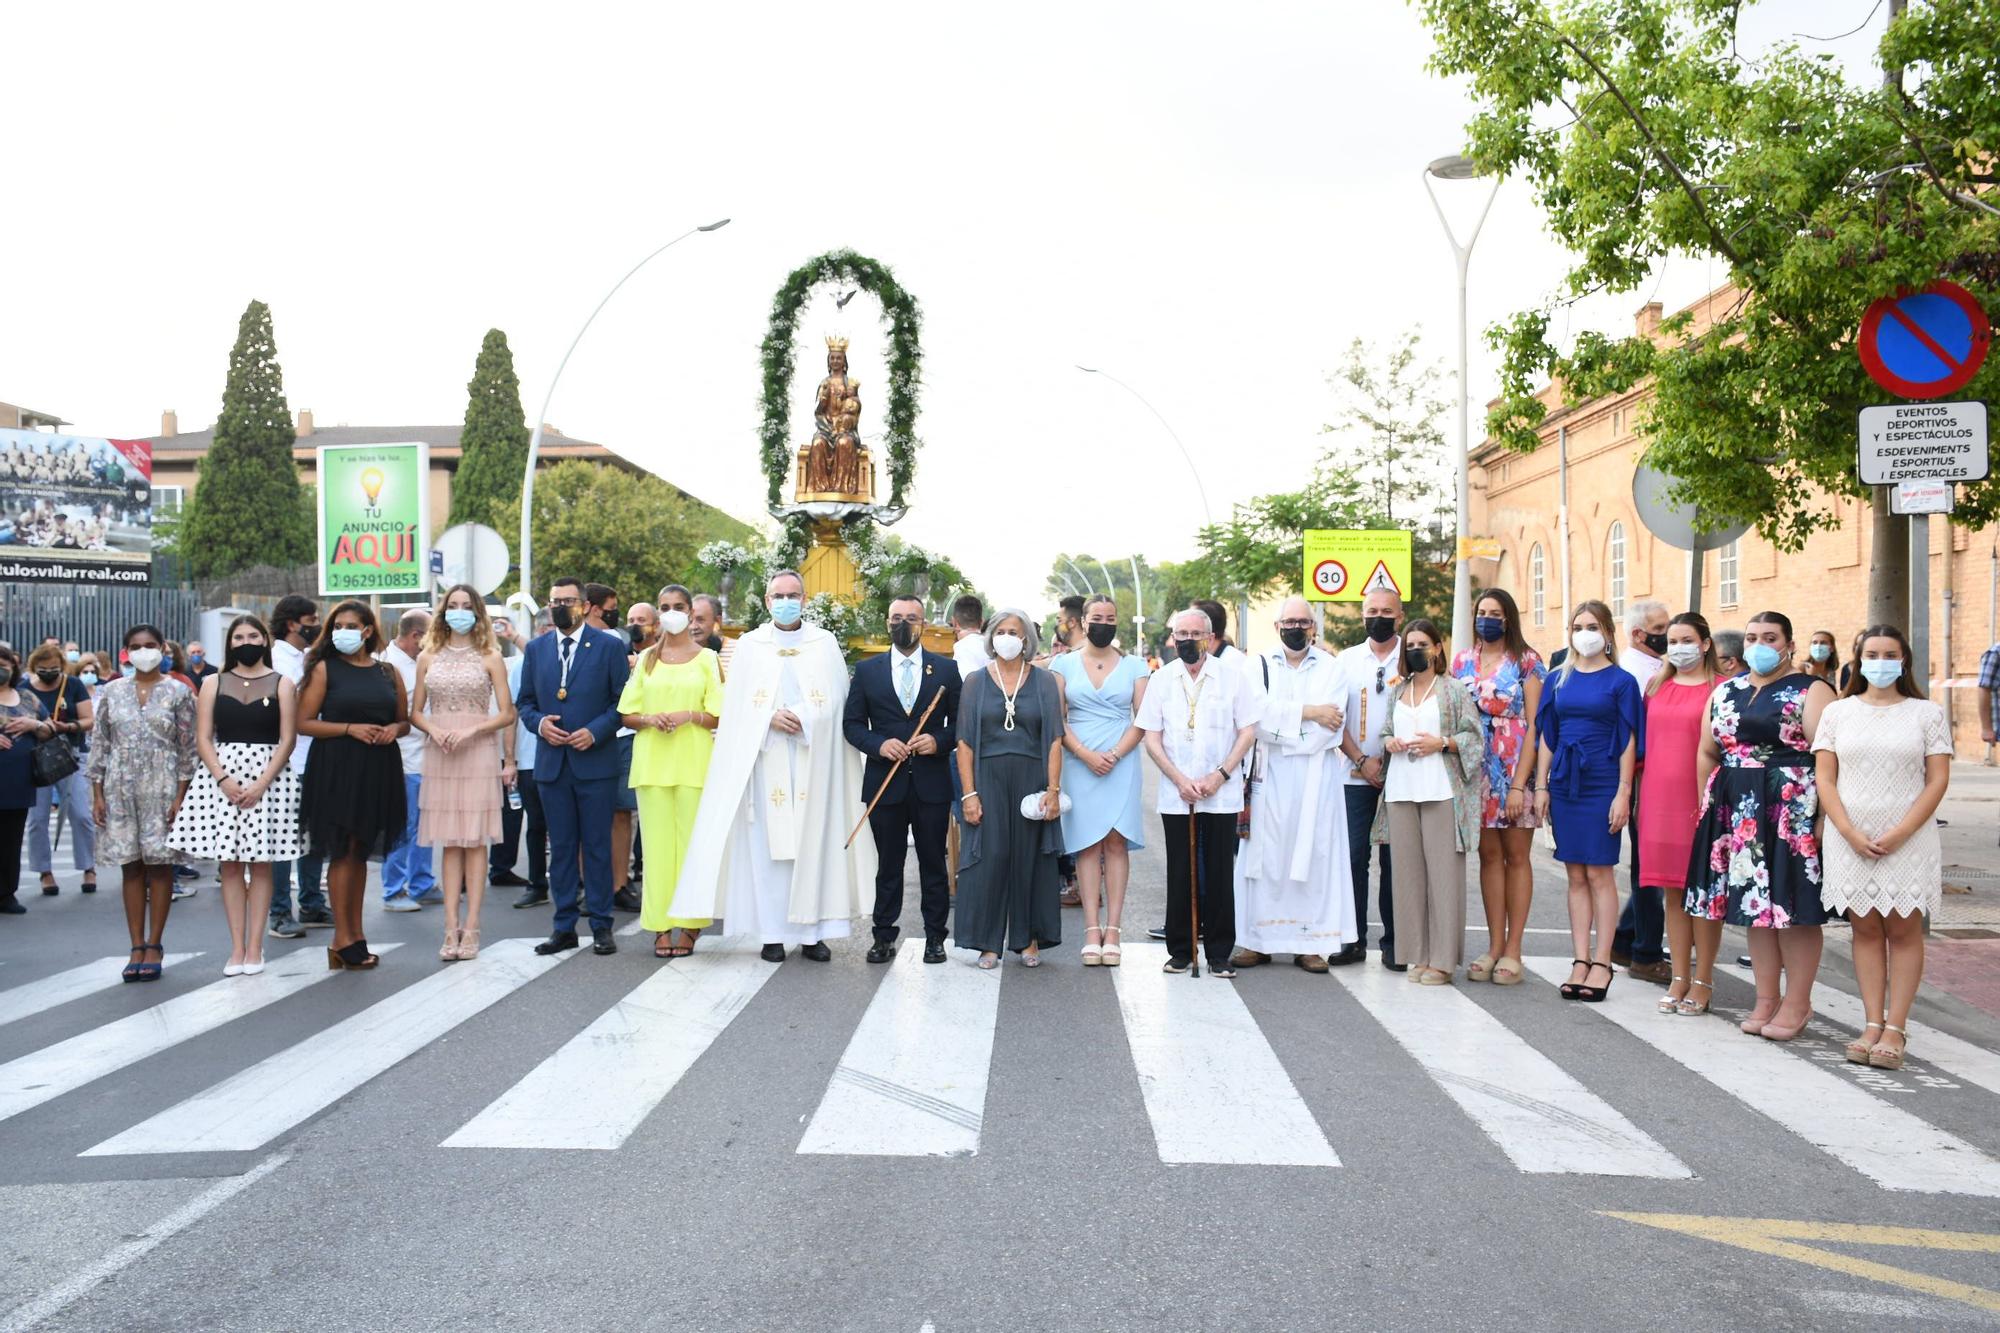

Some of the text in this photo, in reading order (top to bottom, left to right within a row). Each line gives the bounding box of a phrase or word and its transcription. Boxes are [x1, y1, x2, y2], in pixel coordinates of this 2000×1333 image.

[1896, 406, 1948, 417] EVENTOS
[1887, 418, 1957, 430] DEPORTIVOS
[1873, 428, 1973, 442] Y ESPECTÁCULOS
[1876, 444, 1971, 457] ESDEVENIMENTS
[1892, 456, 1956, 468] ESPORTIUS
[1880, 467, 1968, 480] I ESPECTACLES
[364, 508, 382, 519] TU
[342, 521, 405, 533] ANUNCIO
[330, 523, 418, 568] AQUÍ
[343, 573, 418, 588] 962910853
[1320, 572, 1340, 583] 30
